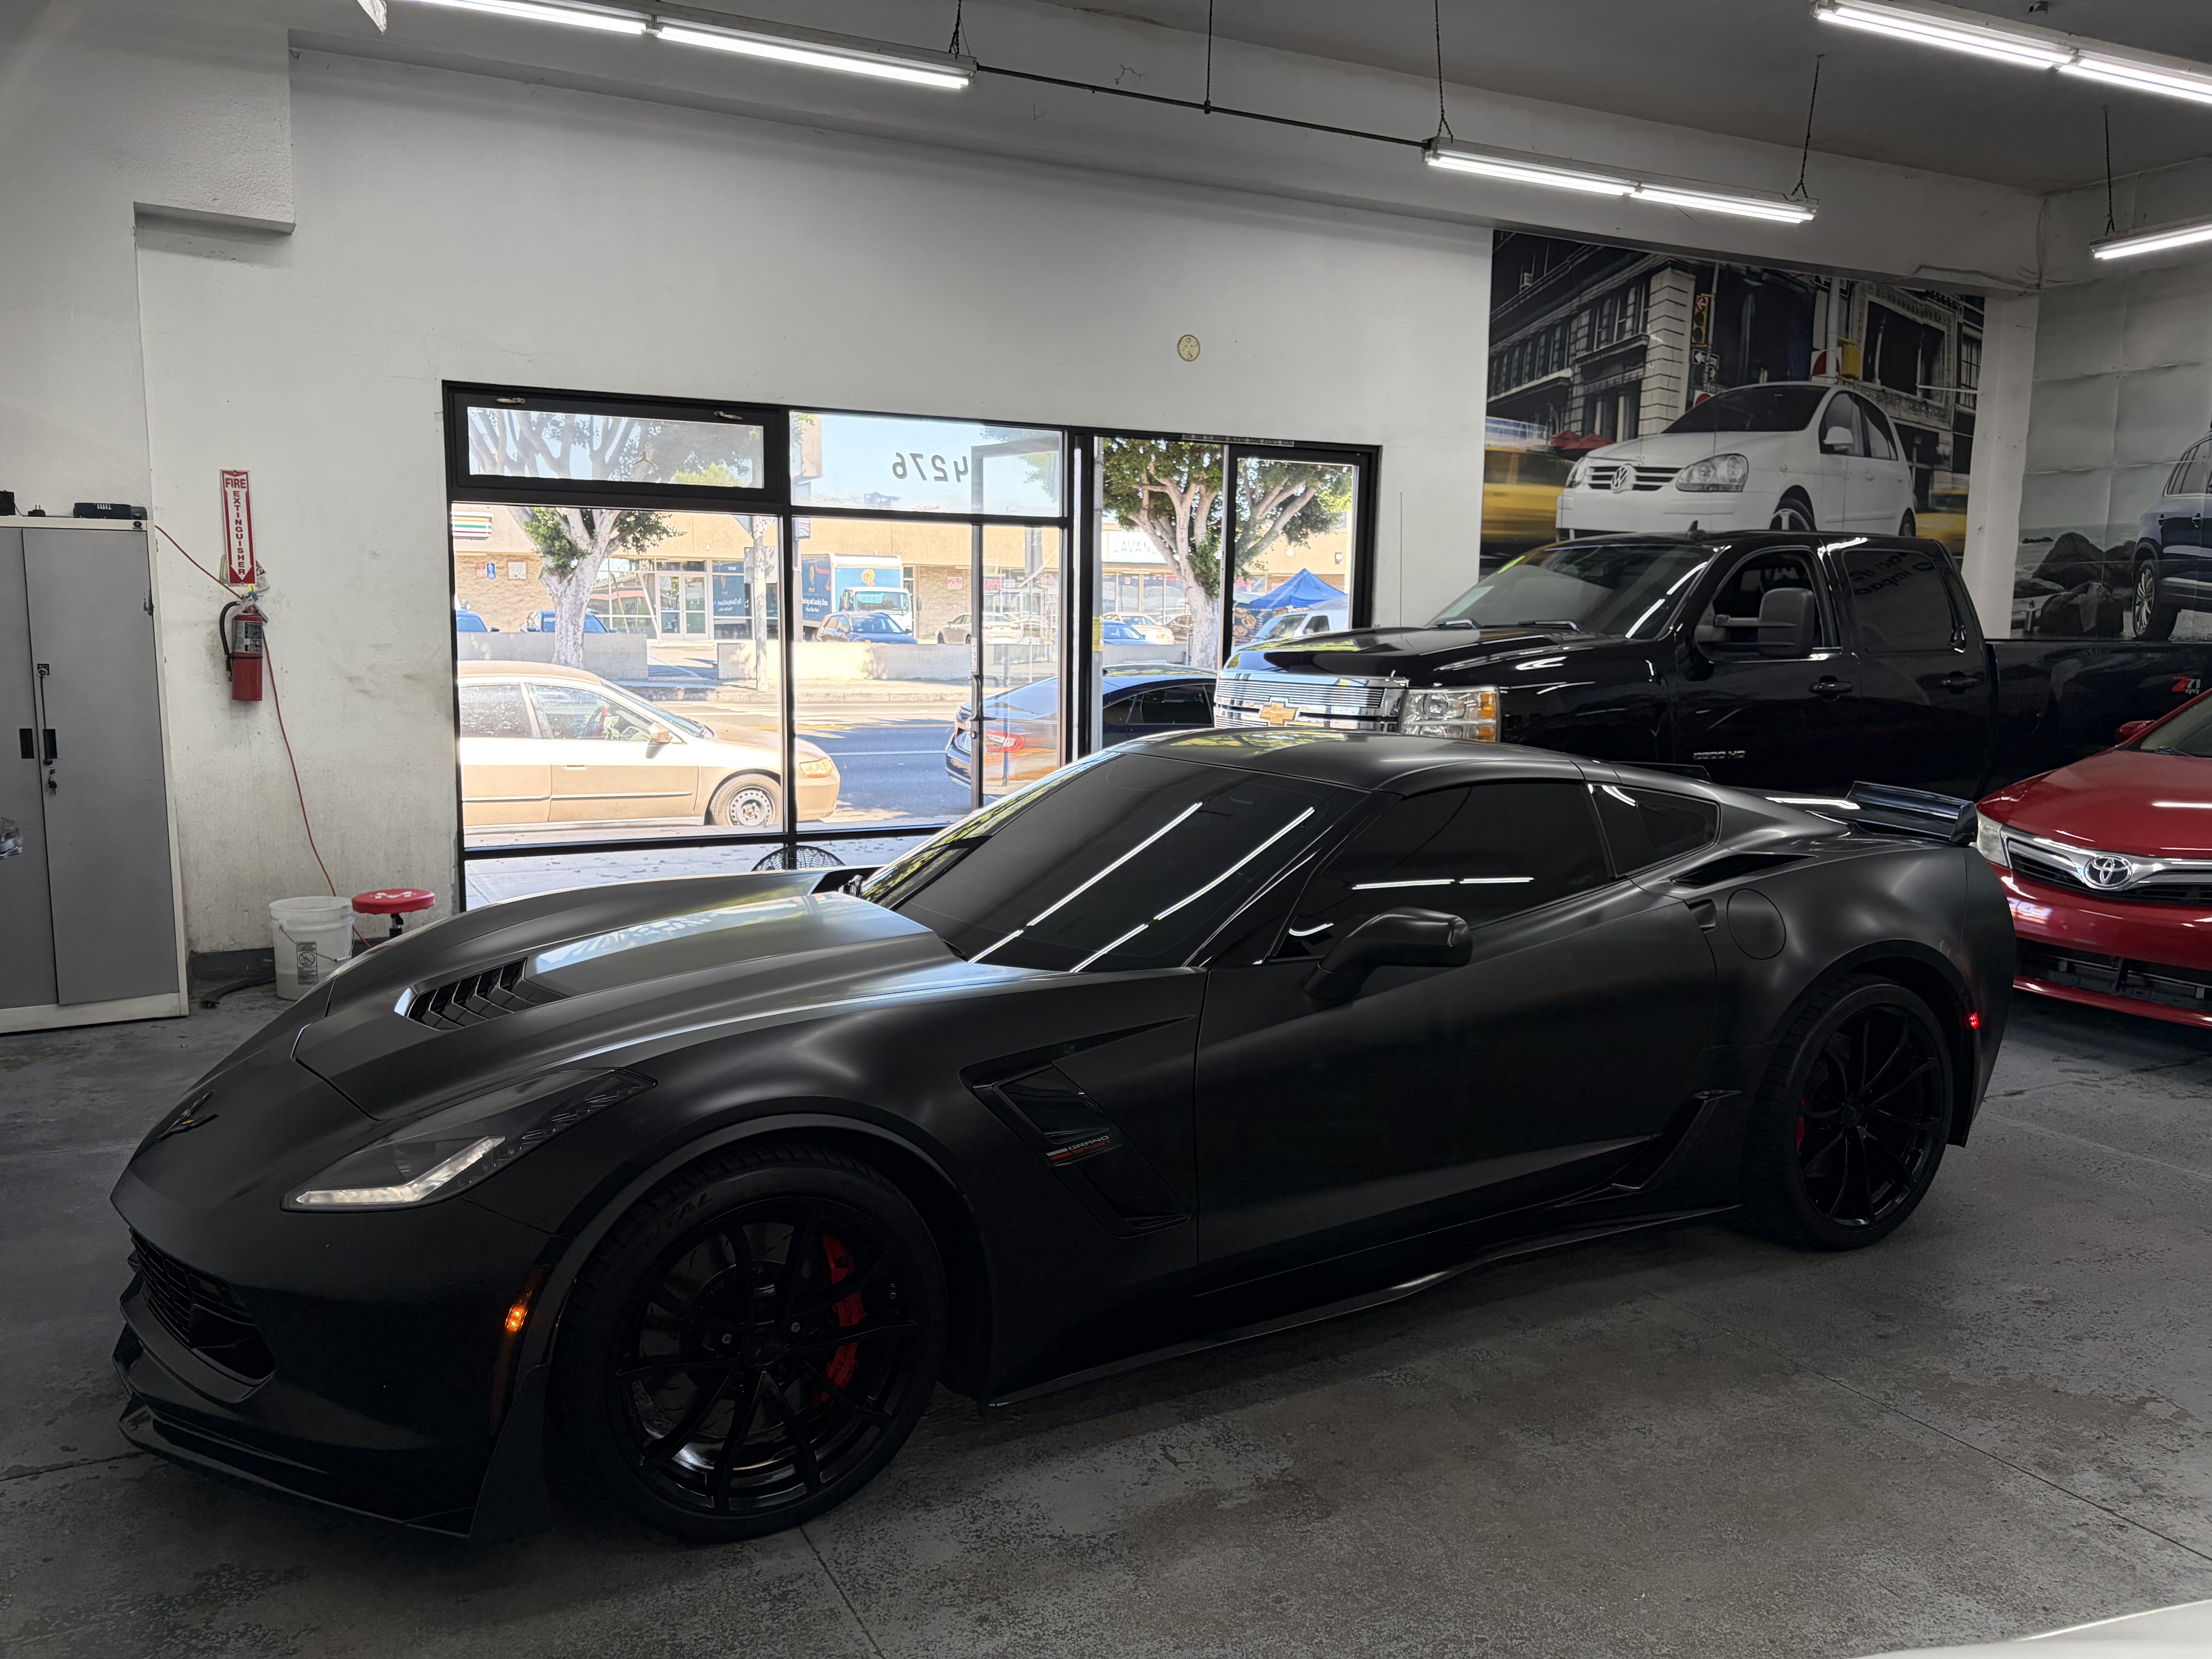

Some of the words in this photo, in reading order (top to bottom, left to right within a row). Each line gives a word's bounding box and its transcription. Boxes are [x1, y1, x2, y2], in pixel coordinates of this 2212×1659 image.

[225, 478, 246, 489] FIRE
[232, 490, 246, 575] EXTINGUISHER
[2172, 677, 2201, 693] Z71
[1068, 1135, 1110, 1151] GRAND
[1070, 1139, 1113, 1155] SPORT
